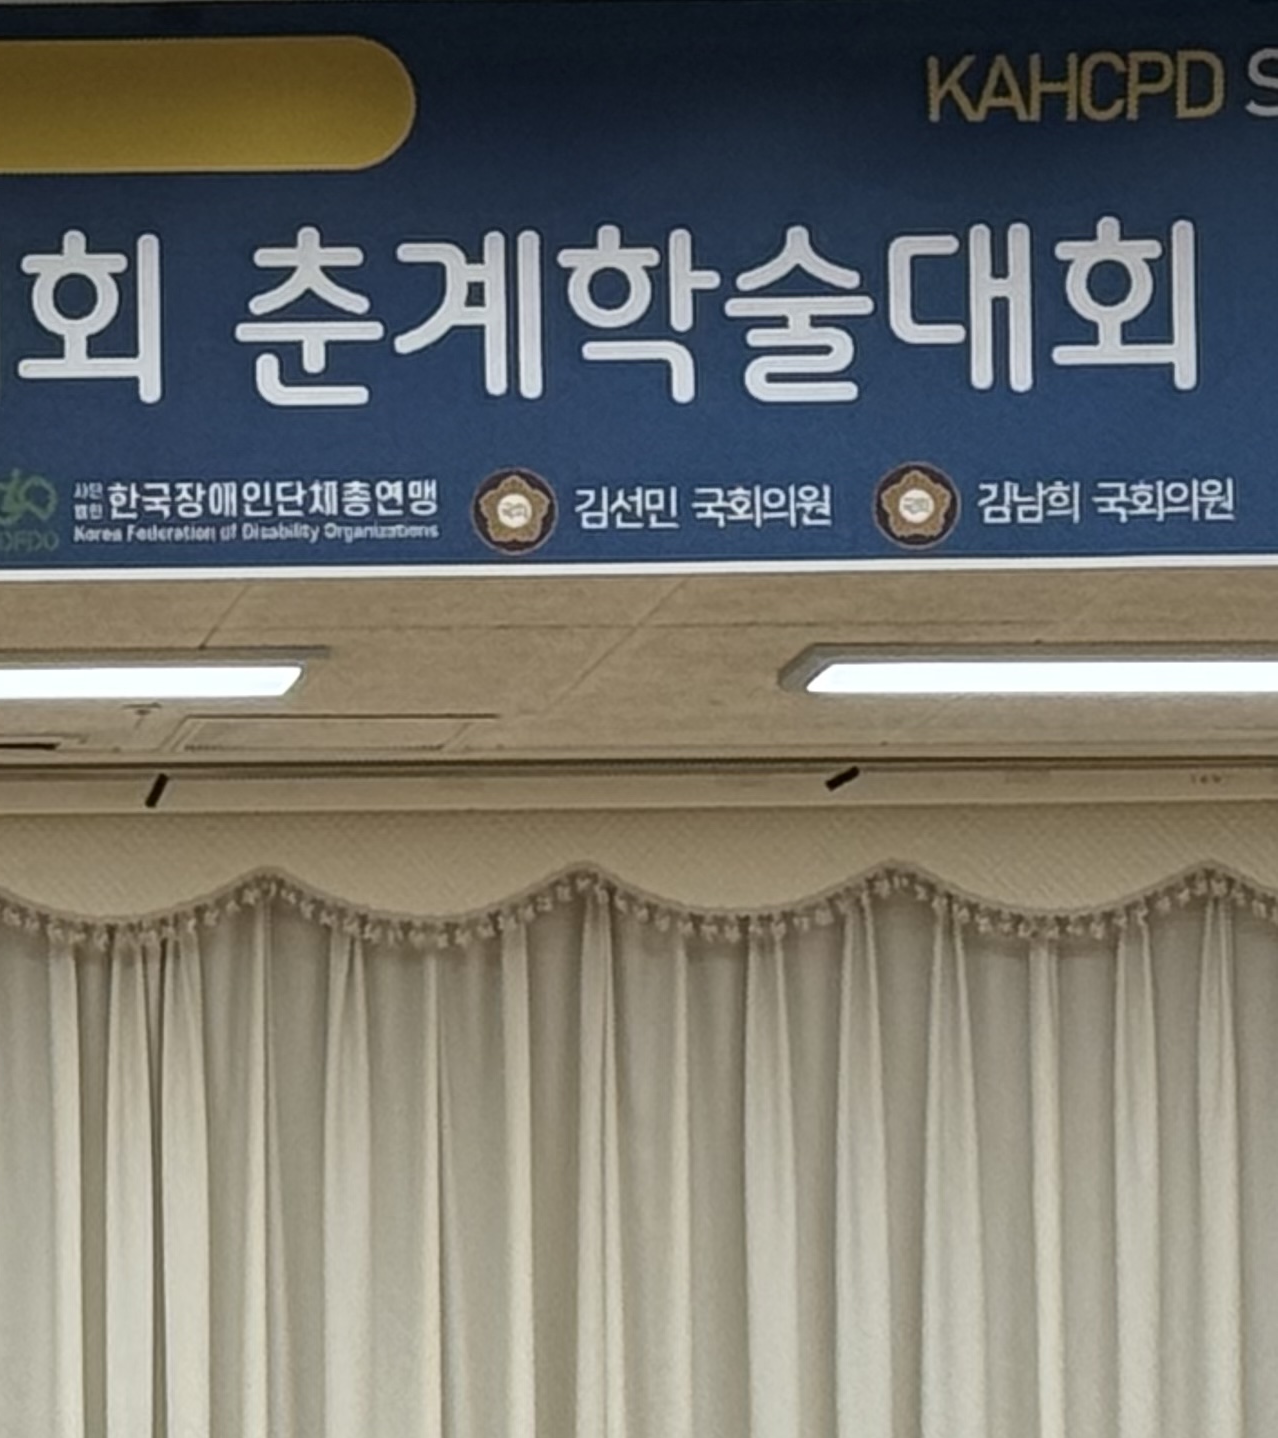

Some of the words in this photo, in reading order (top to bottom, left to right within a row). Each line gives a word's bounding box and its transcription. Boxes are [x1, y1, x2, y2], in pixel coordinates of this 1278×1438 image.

[928, 50, 1225, 122] KAHCPD
[236, 217, 1196, 405] 춘계학술대회
[108, 479, 438, 519] 한국장애인단체총연맹
[575, 486, 678, 529] 김선민
[691, 485, 831, 528] 국회의원
[978, 480, 1080, 524] 김남희
[1092, 478, 1234, 523] 국회의원
